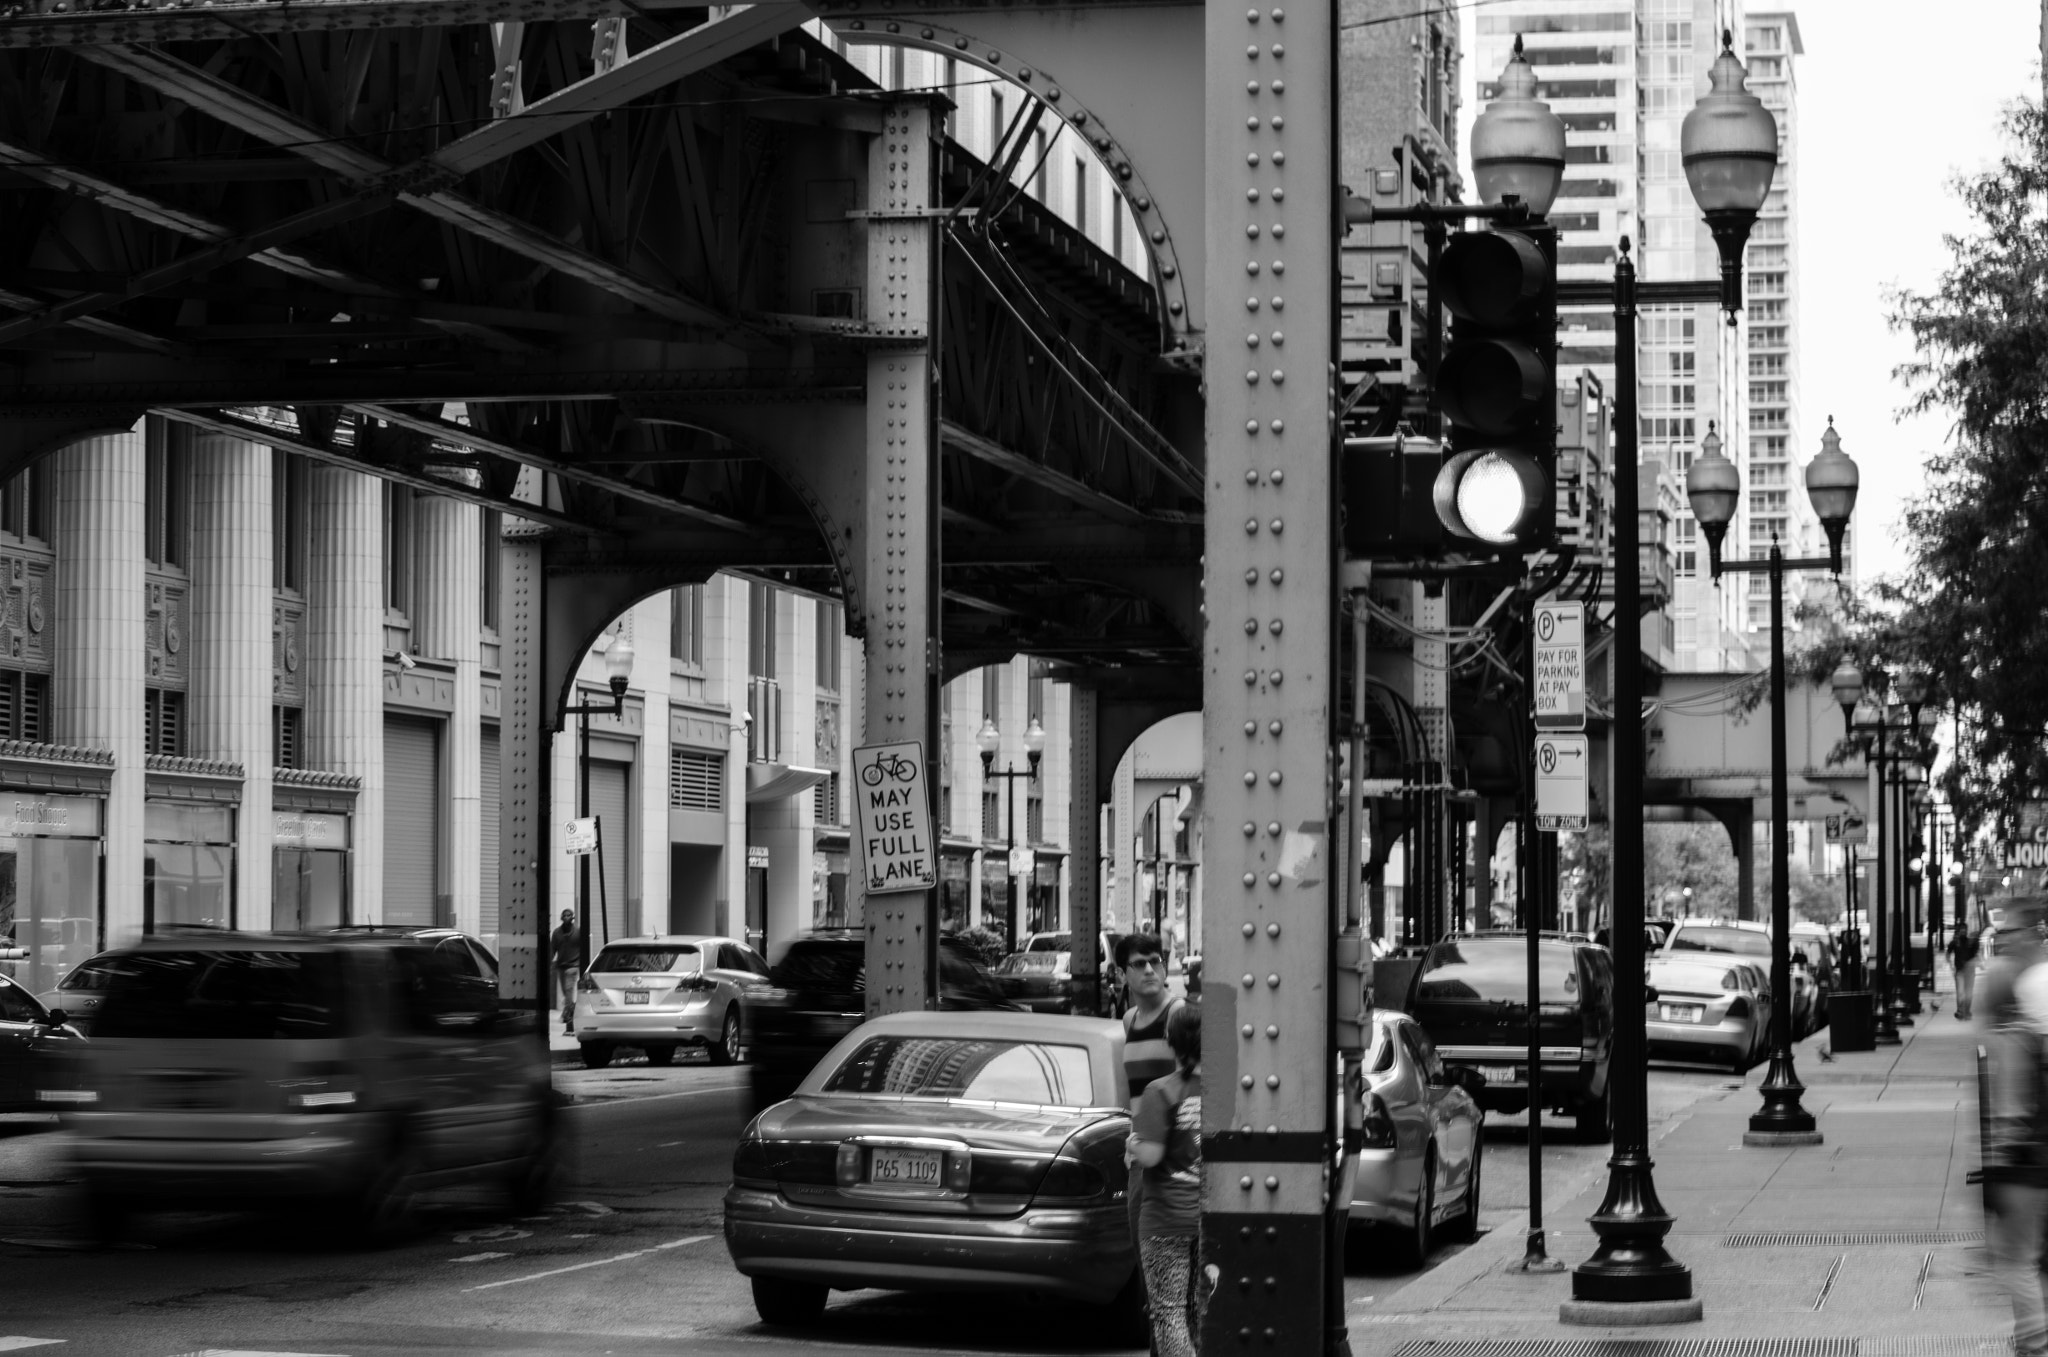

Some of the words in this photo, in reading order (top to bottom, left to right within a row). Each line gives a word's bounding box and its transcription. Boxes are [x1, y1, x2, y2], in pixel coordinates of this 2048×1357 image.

[1538, 650, 1555, 663] PAY
[1559, 649, 1577, 663] FOR
[1538, 664, 1579, 679] PARKING
[1539, 681, 1549, 694] AT
[1553, 680, 1571, 694] PAY
[1538, 696, 1557, 709] BOX
[870, 787, 912, 809] MAY
[875, 811, 914, 832] USE
[1540, 816, 1556, 828] TOW
[1560, 816, 1582, 829] ZONE
[869, 834, 925, 858] FULL
[872, 859, 924, 882] LANE
[875, 1159, 899, 1178] P65
[906, 1161, 938, 1180] 1109
